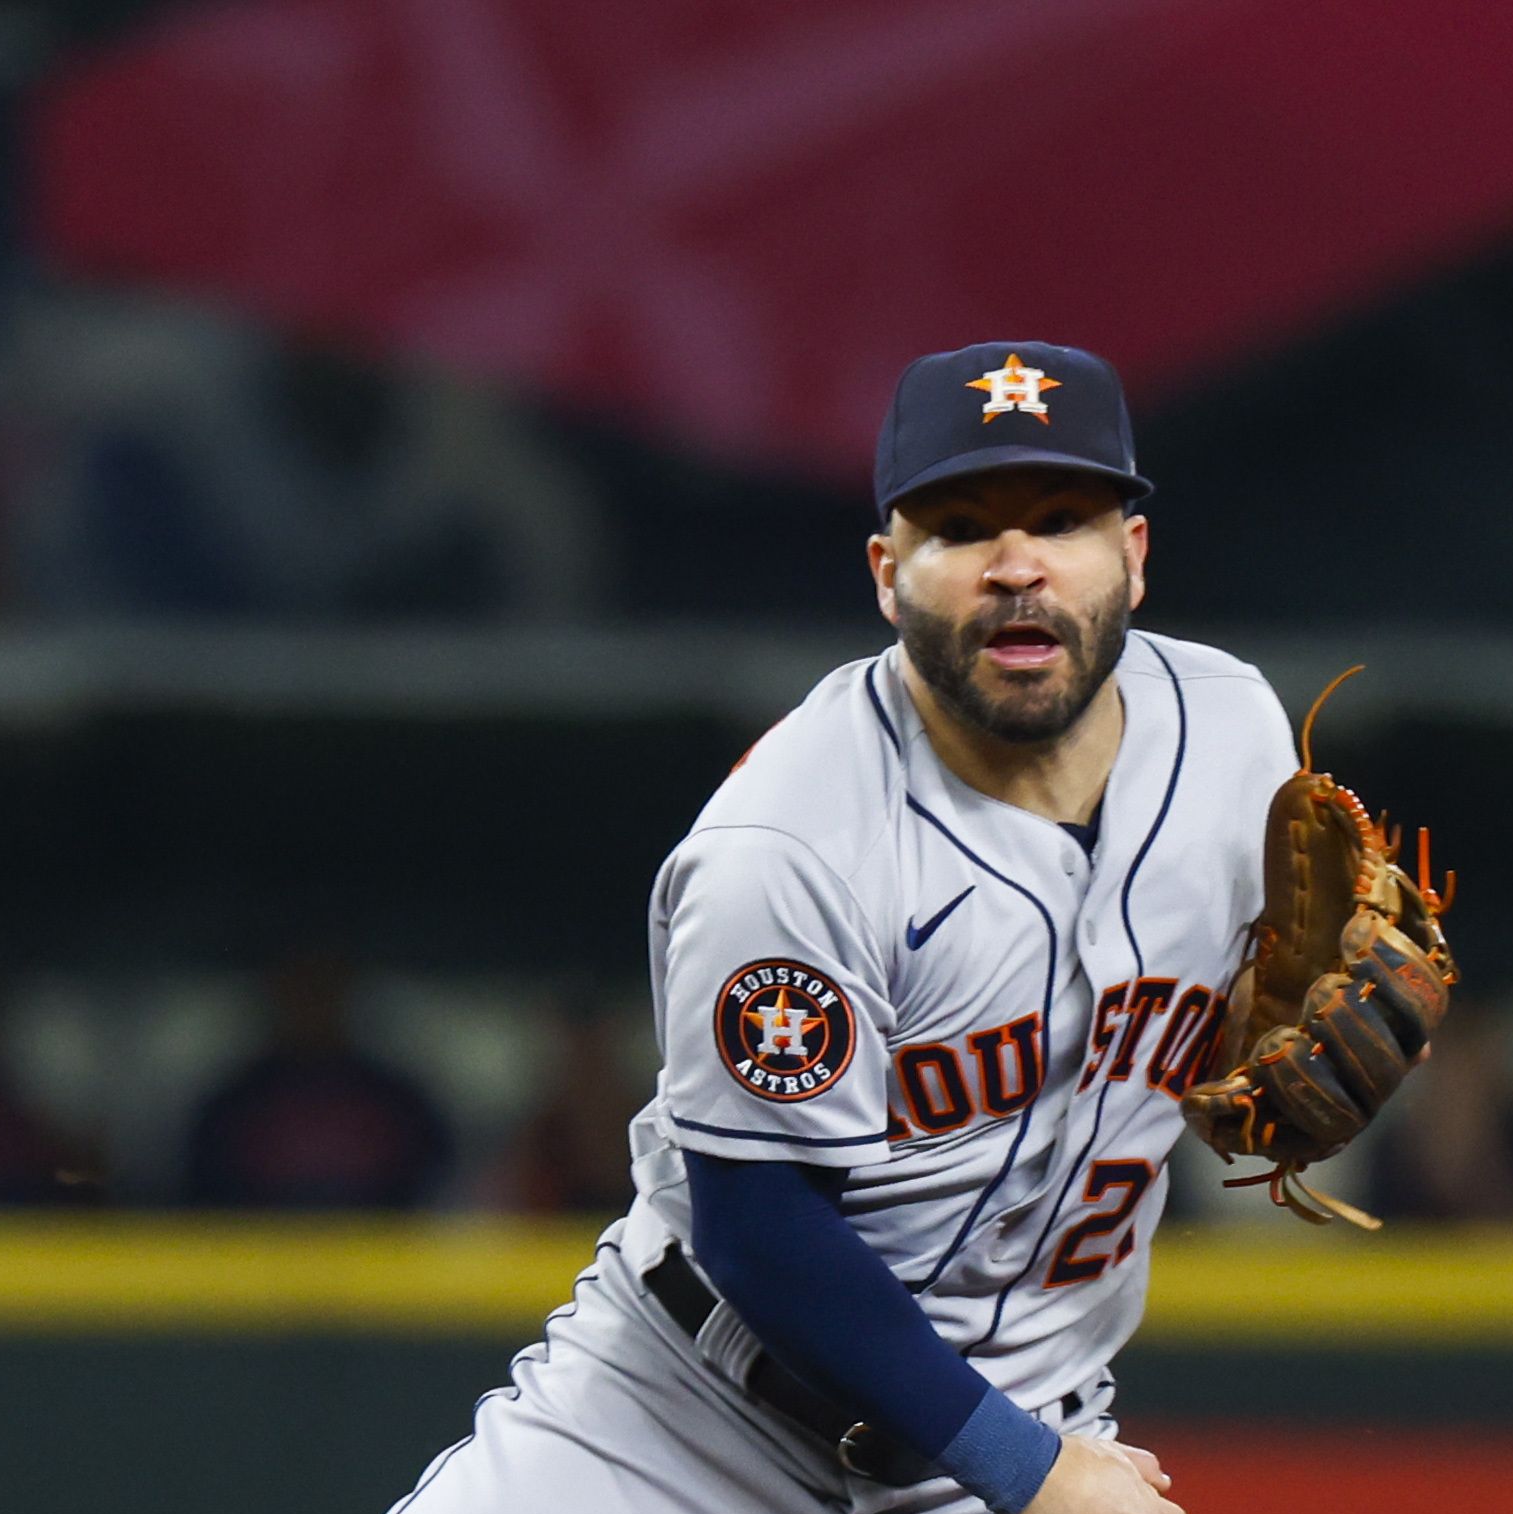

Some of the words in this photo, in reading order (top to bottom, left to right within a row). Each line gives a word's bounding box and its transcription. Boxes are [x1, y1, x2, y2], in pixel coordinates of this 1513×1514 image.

[730, 967, 838, 1009] HOUSTON
[736, 1058, 832, 1094] ASTROS
[888, 976, 1228, 1141] OUSTON
[1043, 1158, 1156, 1289] 2
